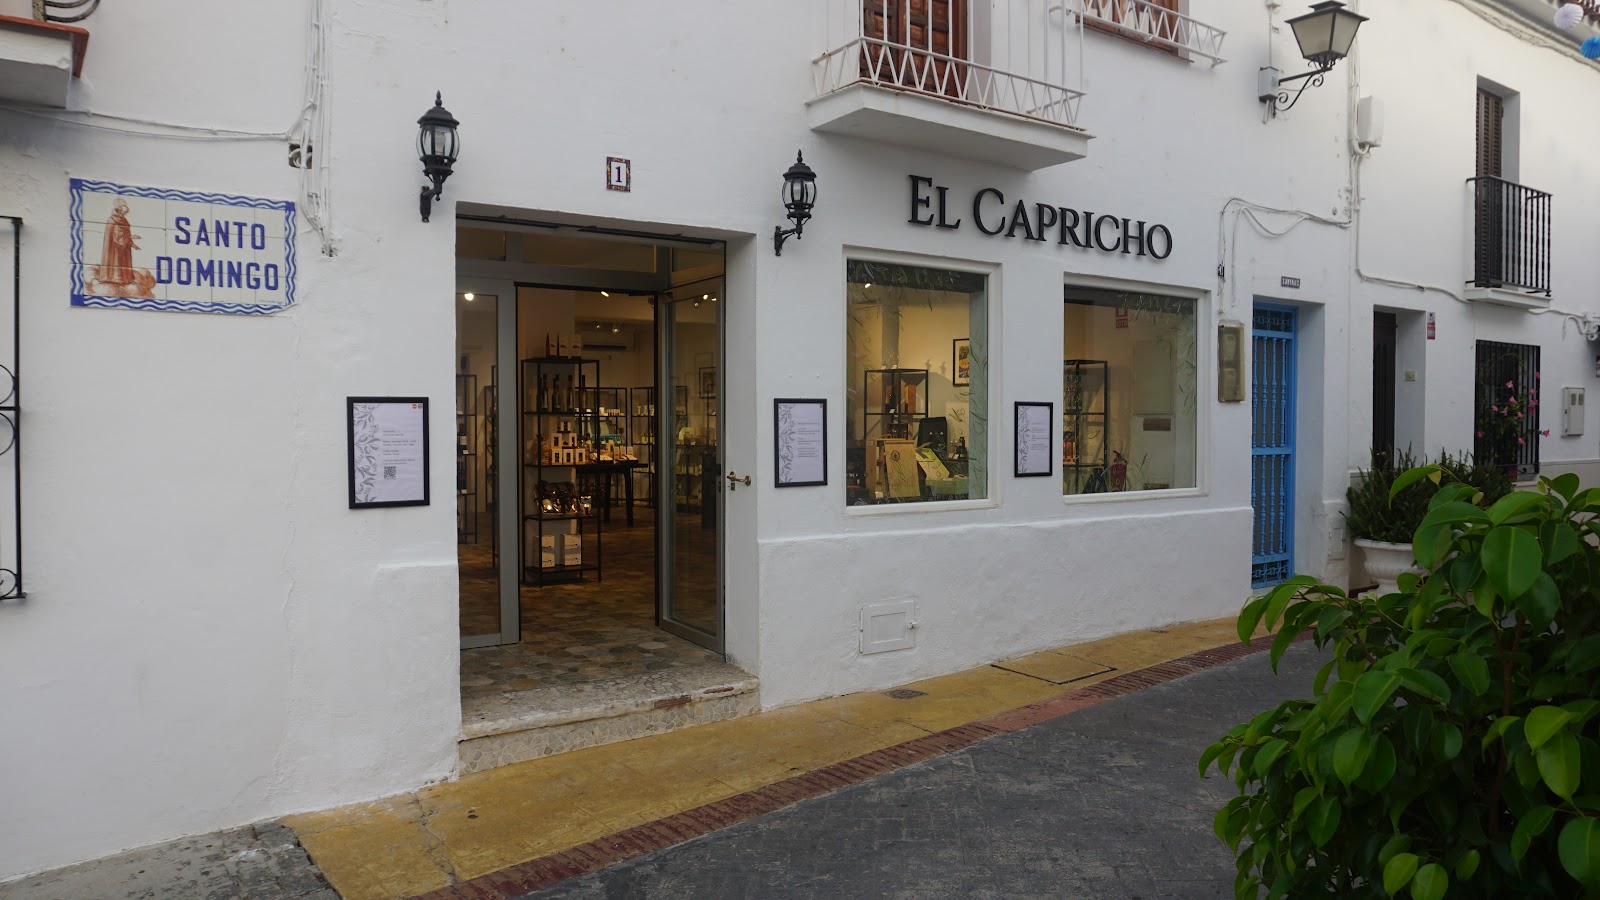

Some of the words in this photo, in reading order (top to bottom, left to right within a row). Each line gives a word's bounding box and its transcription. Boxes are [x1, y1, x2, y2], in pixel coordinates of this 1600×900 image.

[615, 165, 622, 183] 1
[174, 216, 265, 250] SANTO
[908, 174, 961, 229] EL
[973, 187, 1173, 260] CAPRICHO
[156, 256, 279, 291] DOMINGO
